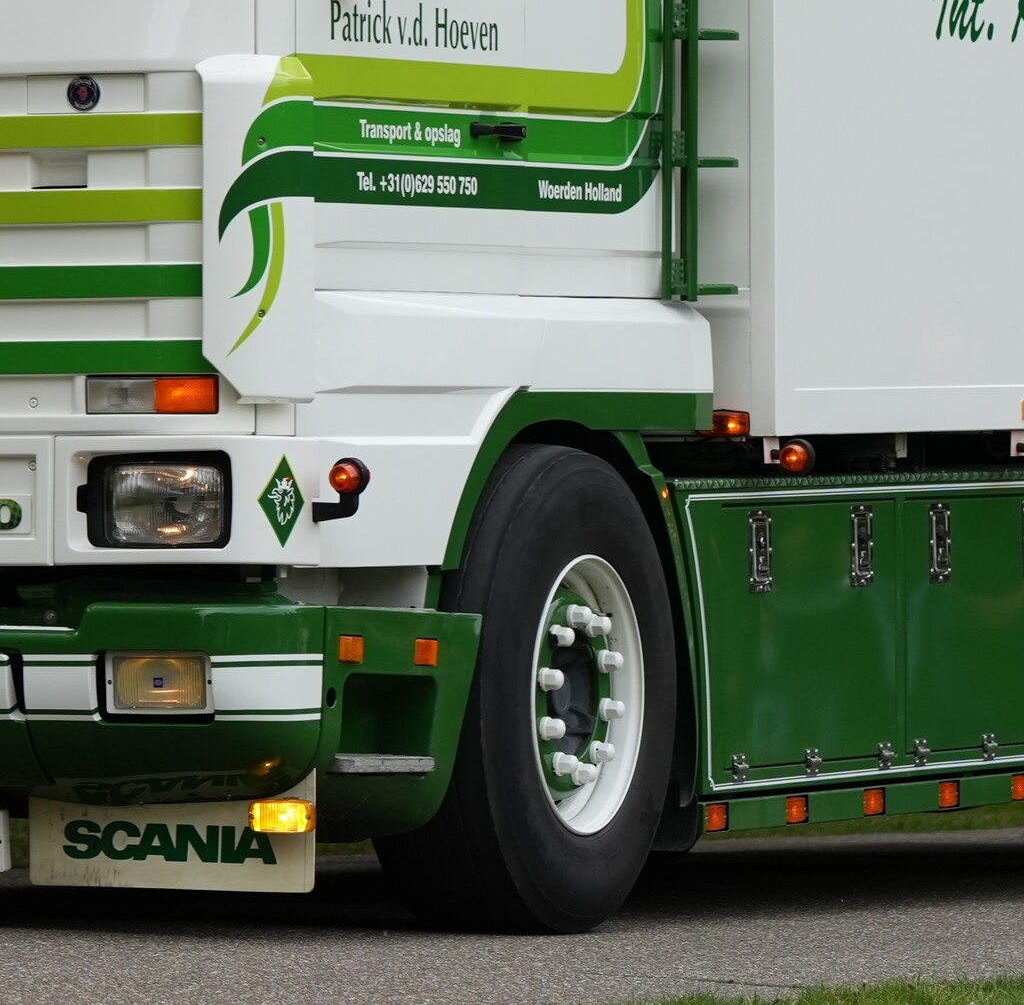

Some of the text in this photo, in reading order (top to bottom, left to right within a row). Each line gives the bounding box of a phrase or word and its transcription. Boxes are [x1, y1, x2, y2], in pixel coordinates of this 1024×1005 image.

[397, 2, 429, 47] v.d.
[435, 7, 499, 52] Hoeven
[359, 118, 461, 148] Transport & opslag
[356, 171, 478, 197] Tel. +31(0)629 550 750
[538, 179, 623, 202] Woerden Holland
[62, 819, 278, 865] SCANIA
